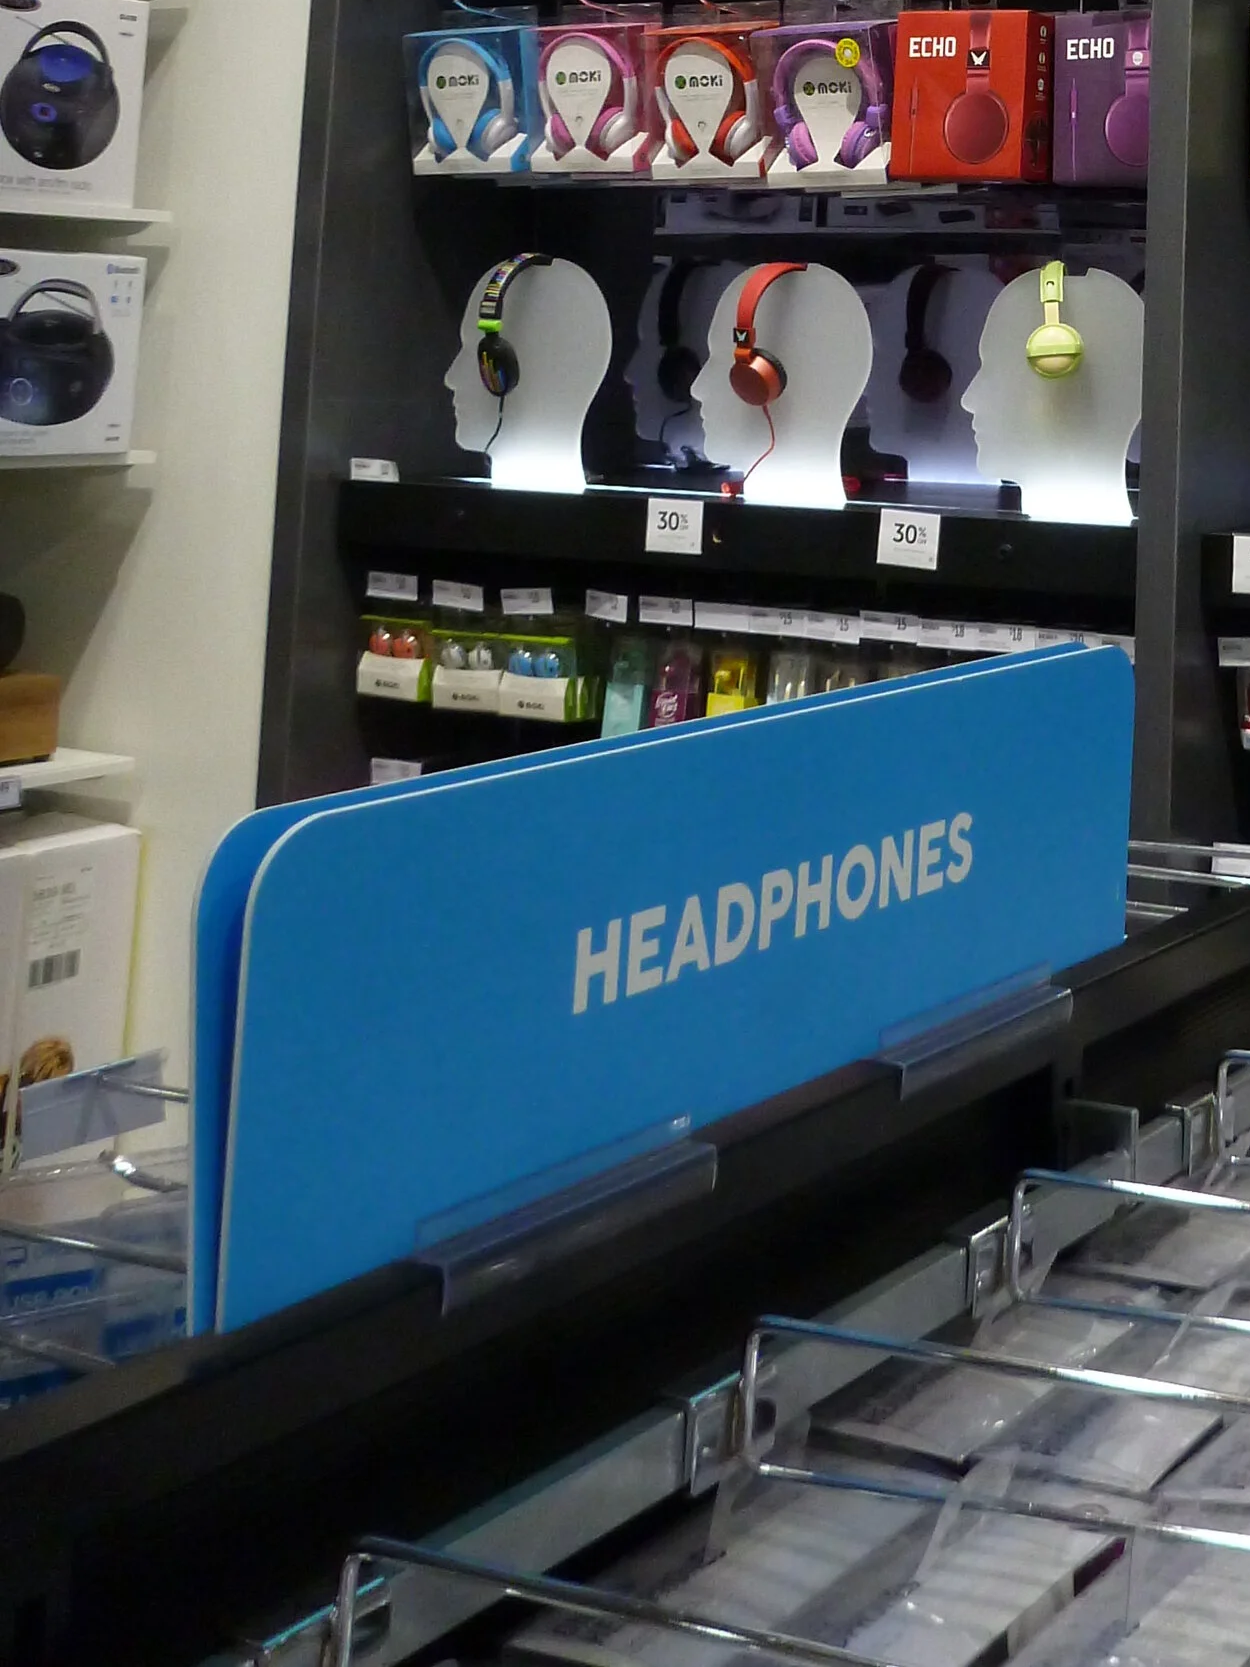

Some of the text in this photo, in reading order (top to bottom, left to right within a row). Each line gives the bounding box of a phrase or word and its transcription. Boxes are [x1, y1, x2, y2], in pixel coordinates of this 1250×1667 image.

[909, 36, 957, 58] ECHO
[1066, 37, 1115, 60] ECHO
[657, 510, 688, 531] 30%
[892, 522, 927, 545] 30%
[572, 811, 975, 1015] HEADPHONES
